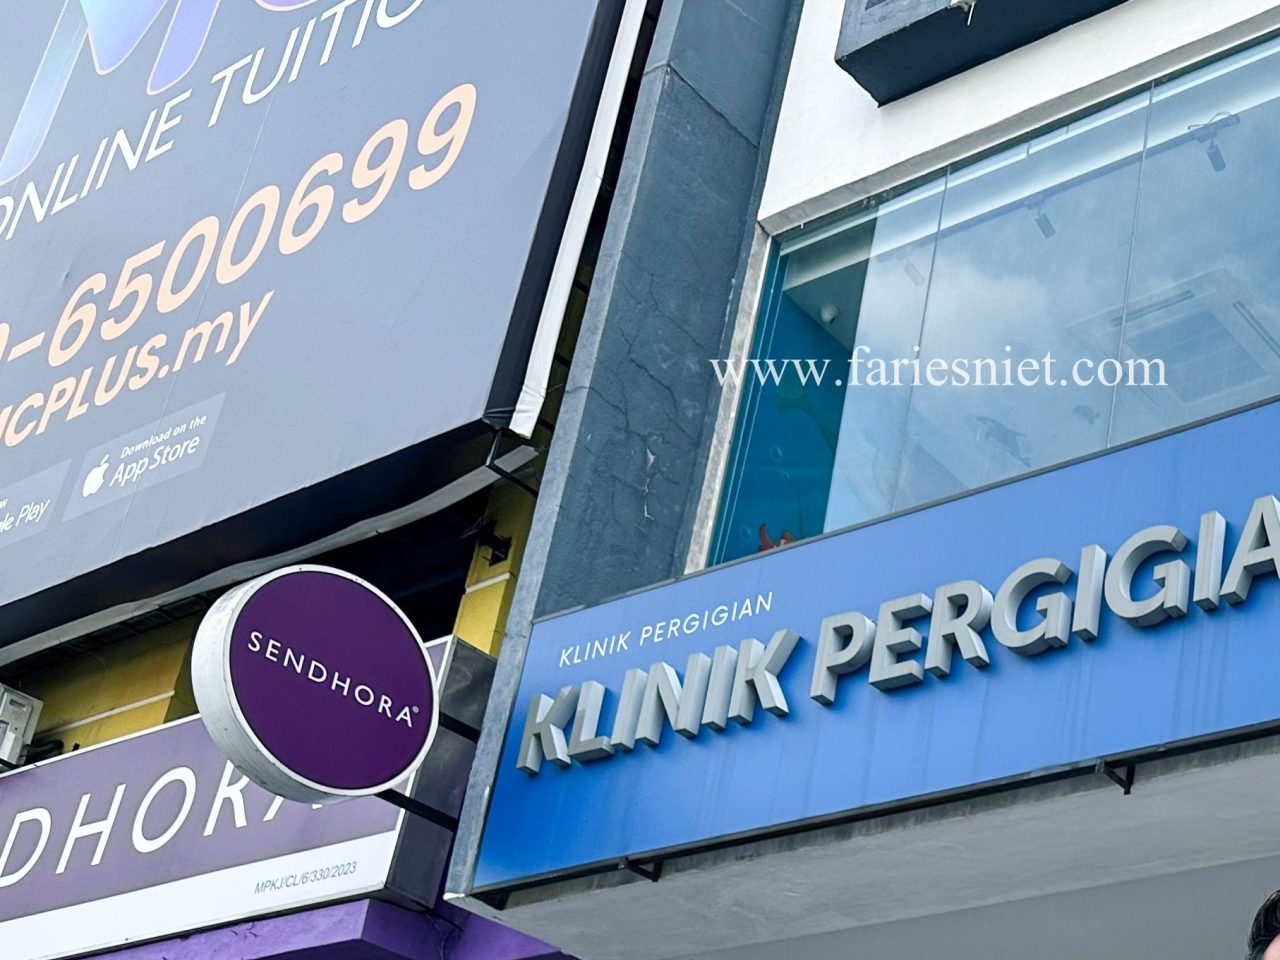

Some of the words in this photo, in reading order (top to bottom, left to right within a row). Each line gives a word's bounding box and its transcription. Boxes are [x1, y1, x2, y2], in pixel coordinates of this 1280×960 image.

[109, 462, 149, 487] App
[149, 436, 200, 470] Store
[120, 427, 172, 459] Download
[173, 424, 187, 436] on
[189, 415, 207, 430] the
[15, 499, 50, 527] Play
[559, 631, 632, 668] KLINIK
[639, 591, 773, 646] PERGIGIAN
[248, 631, 413, 728] SENDHORA
[516, 627, 802, 775] KLINIK
[0, 758, 325, 888] DHOR
